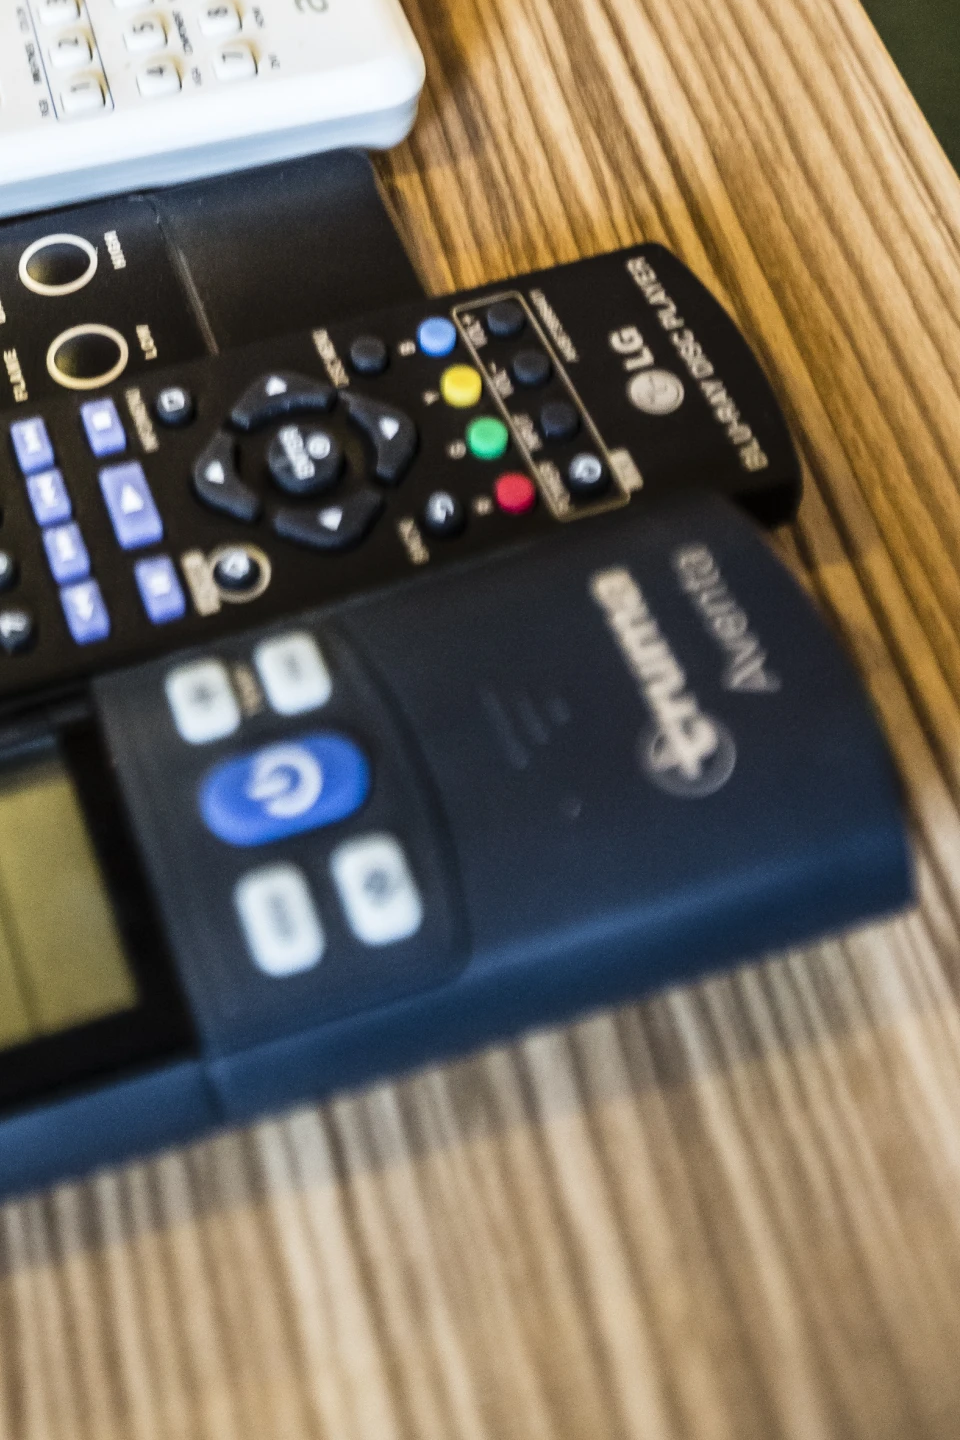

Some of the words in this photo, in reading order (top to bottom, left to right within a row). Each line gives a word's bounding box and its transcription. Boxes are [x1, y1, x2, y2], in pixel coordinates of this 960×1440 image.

[58, 37, 79, 48] 2
[133, 21, 154, 34] 5
[104, 230, 126, 269] HIGH
[627, 256, 684, 331] PLAYER
[136, 324, 157, 360] LOW
[609, 325, 654, 371] LG
[671, 328, 714, 379] DISC
[3, 348, 28, 402] FLAME
[701, 379, 769, 472] BLU-RAY
[278, 424, 316, 480] ENTER
[674, 542, 782, 692] Aventa
[591, 566, 717, 781] truma
